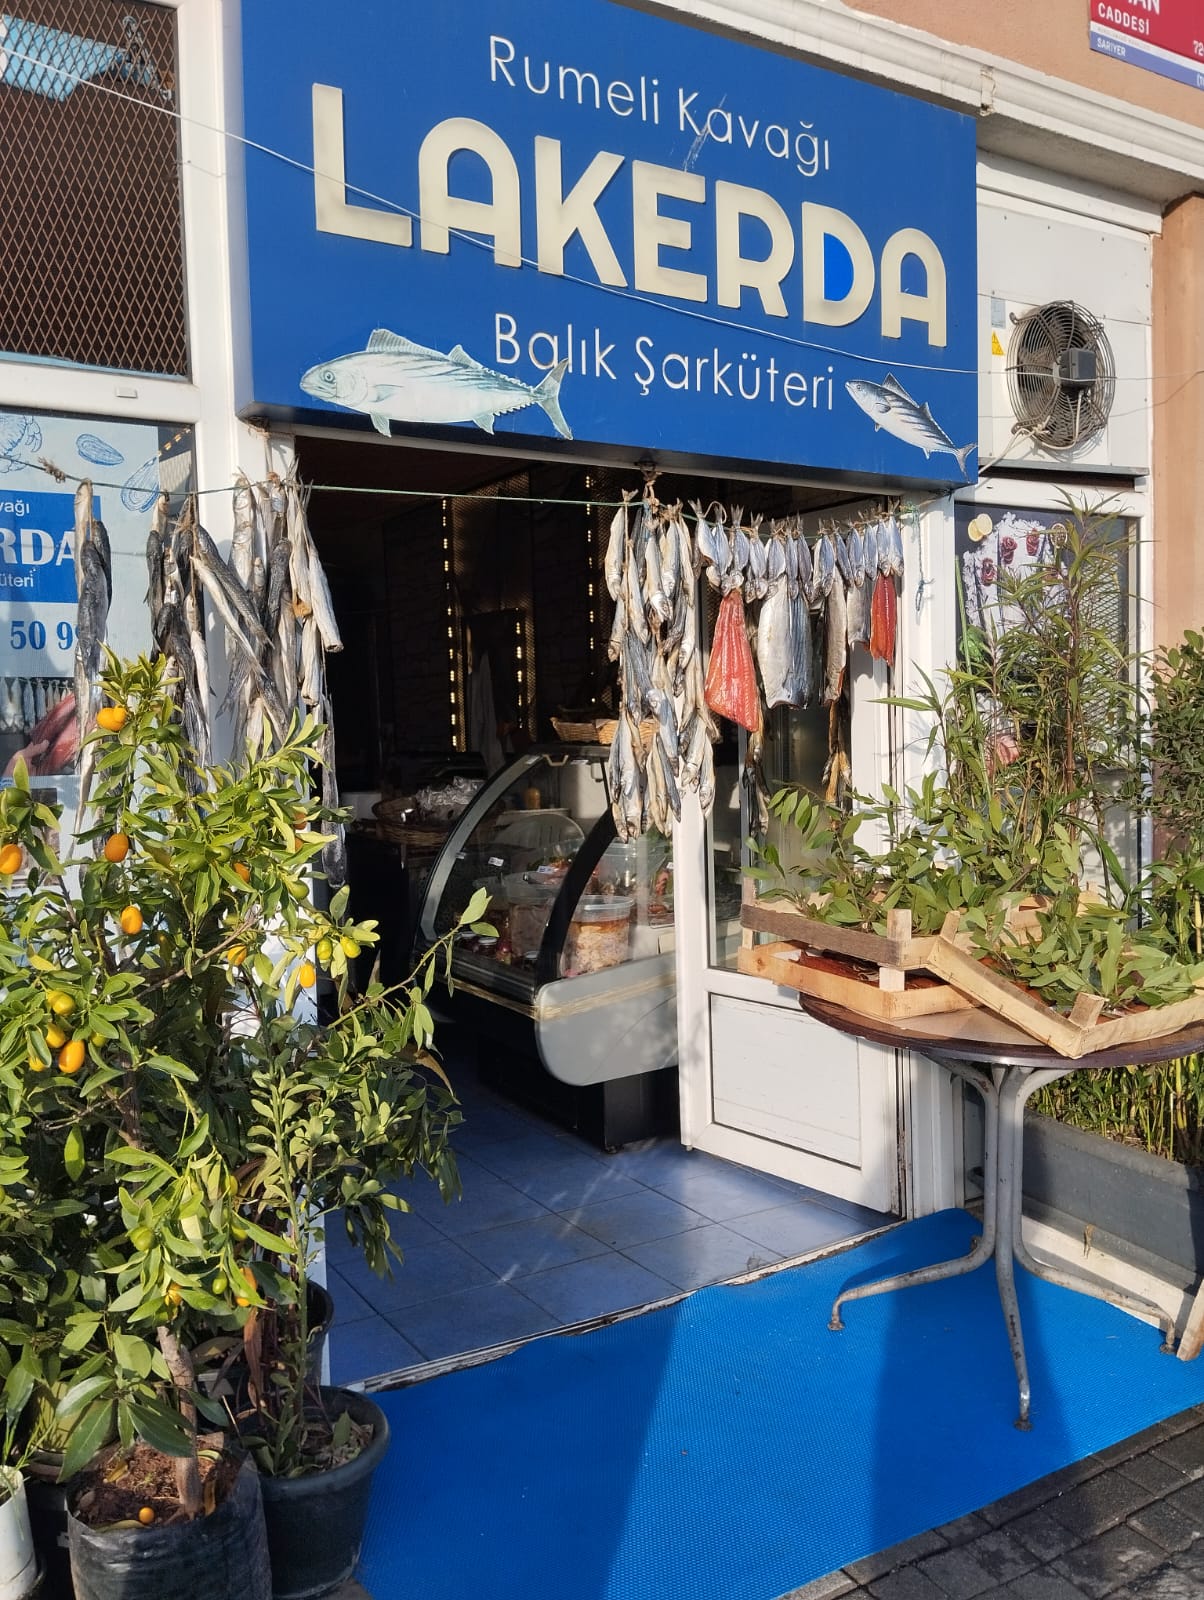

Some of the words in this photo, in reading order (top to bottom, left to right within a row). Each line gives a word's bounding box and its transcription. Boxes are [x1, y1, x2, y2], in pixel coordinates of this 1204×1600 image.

[489, 34, 660, 125] Rumeli
[678, 87, 830, 177] Kavağı
[311, 82, 947, 348] LAKERDA
[494, 312, 617, 380] Balık
[634, 335, 834, 411] Şarküteri
[10, 620, 46, 650] 50
[56, 621, 80, 650] 9
